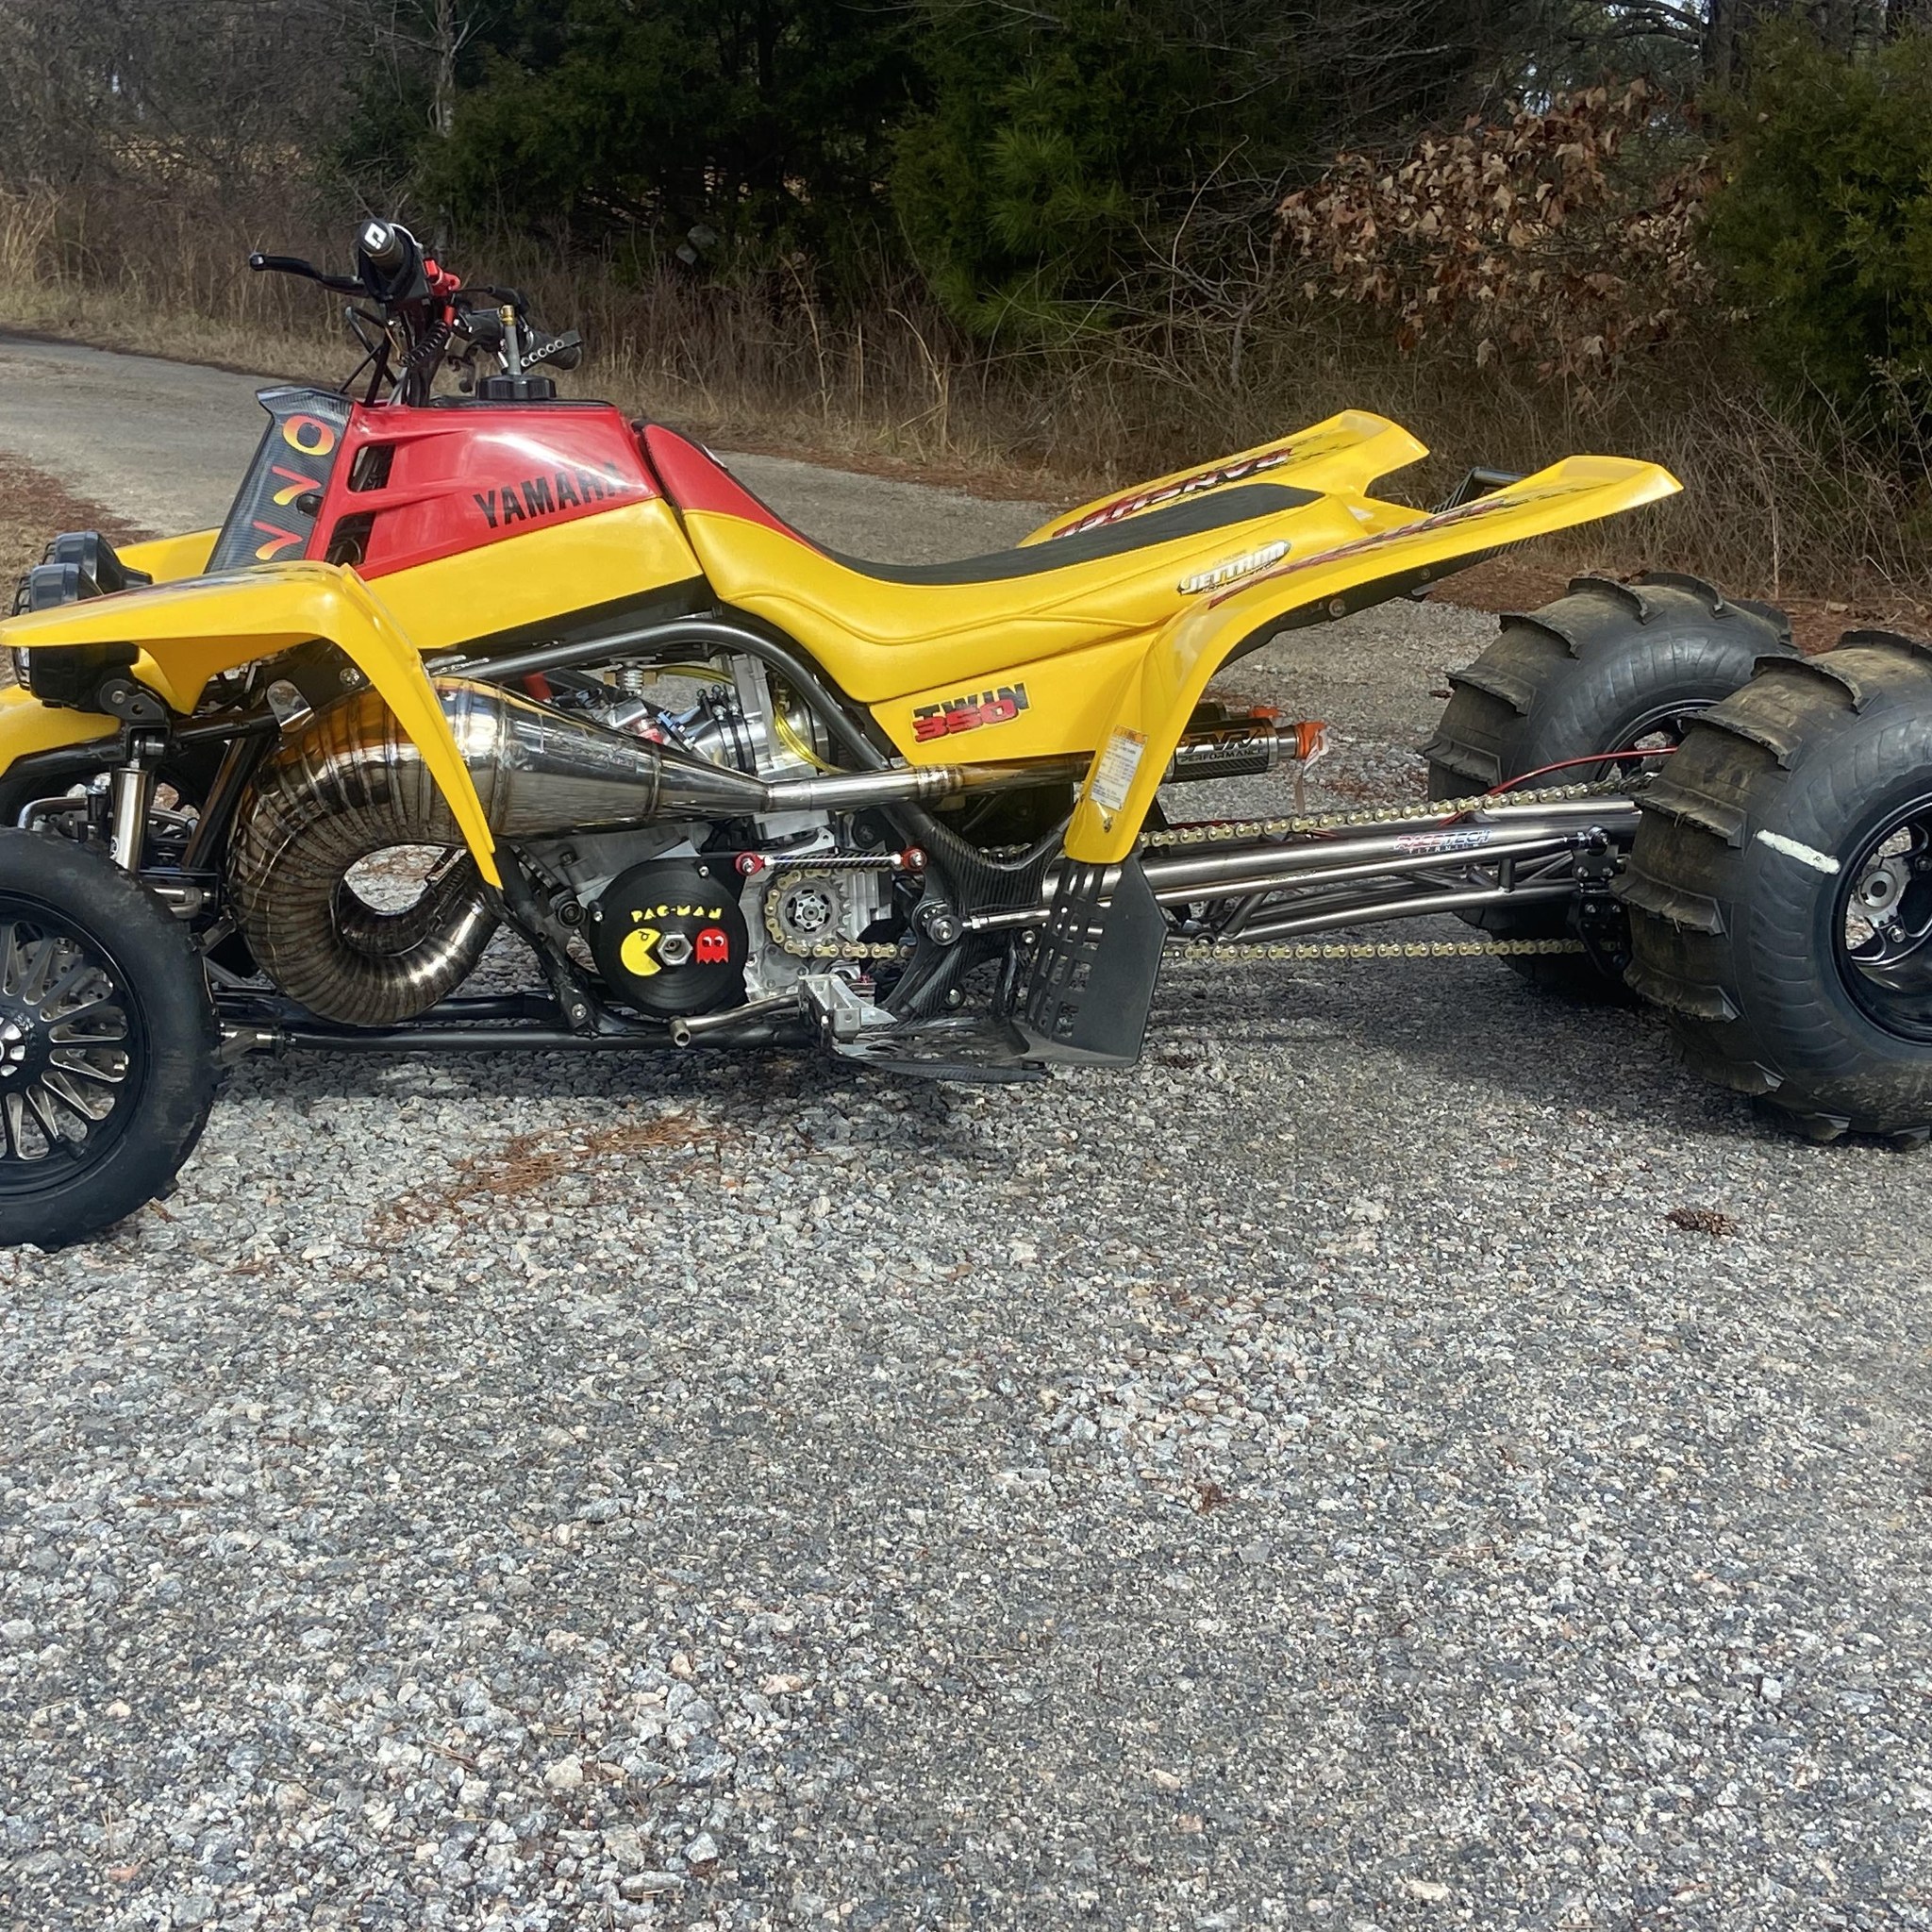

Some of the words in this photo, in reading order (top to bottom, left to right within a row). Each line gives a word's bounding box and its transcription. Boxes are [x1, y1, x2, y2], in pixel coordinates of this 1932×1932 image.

[472, 461, 629, 529] YAMAHA
[912, 699, 1020, 743] 350
[1178, 748, 1265, 763] PERFORMANCE
[1393, 829, 1492, 849] RACETECH
[630, 904, 724, 924] PAC-MAN
